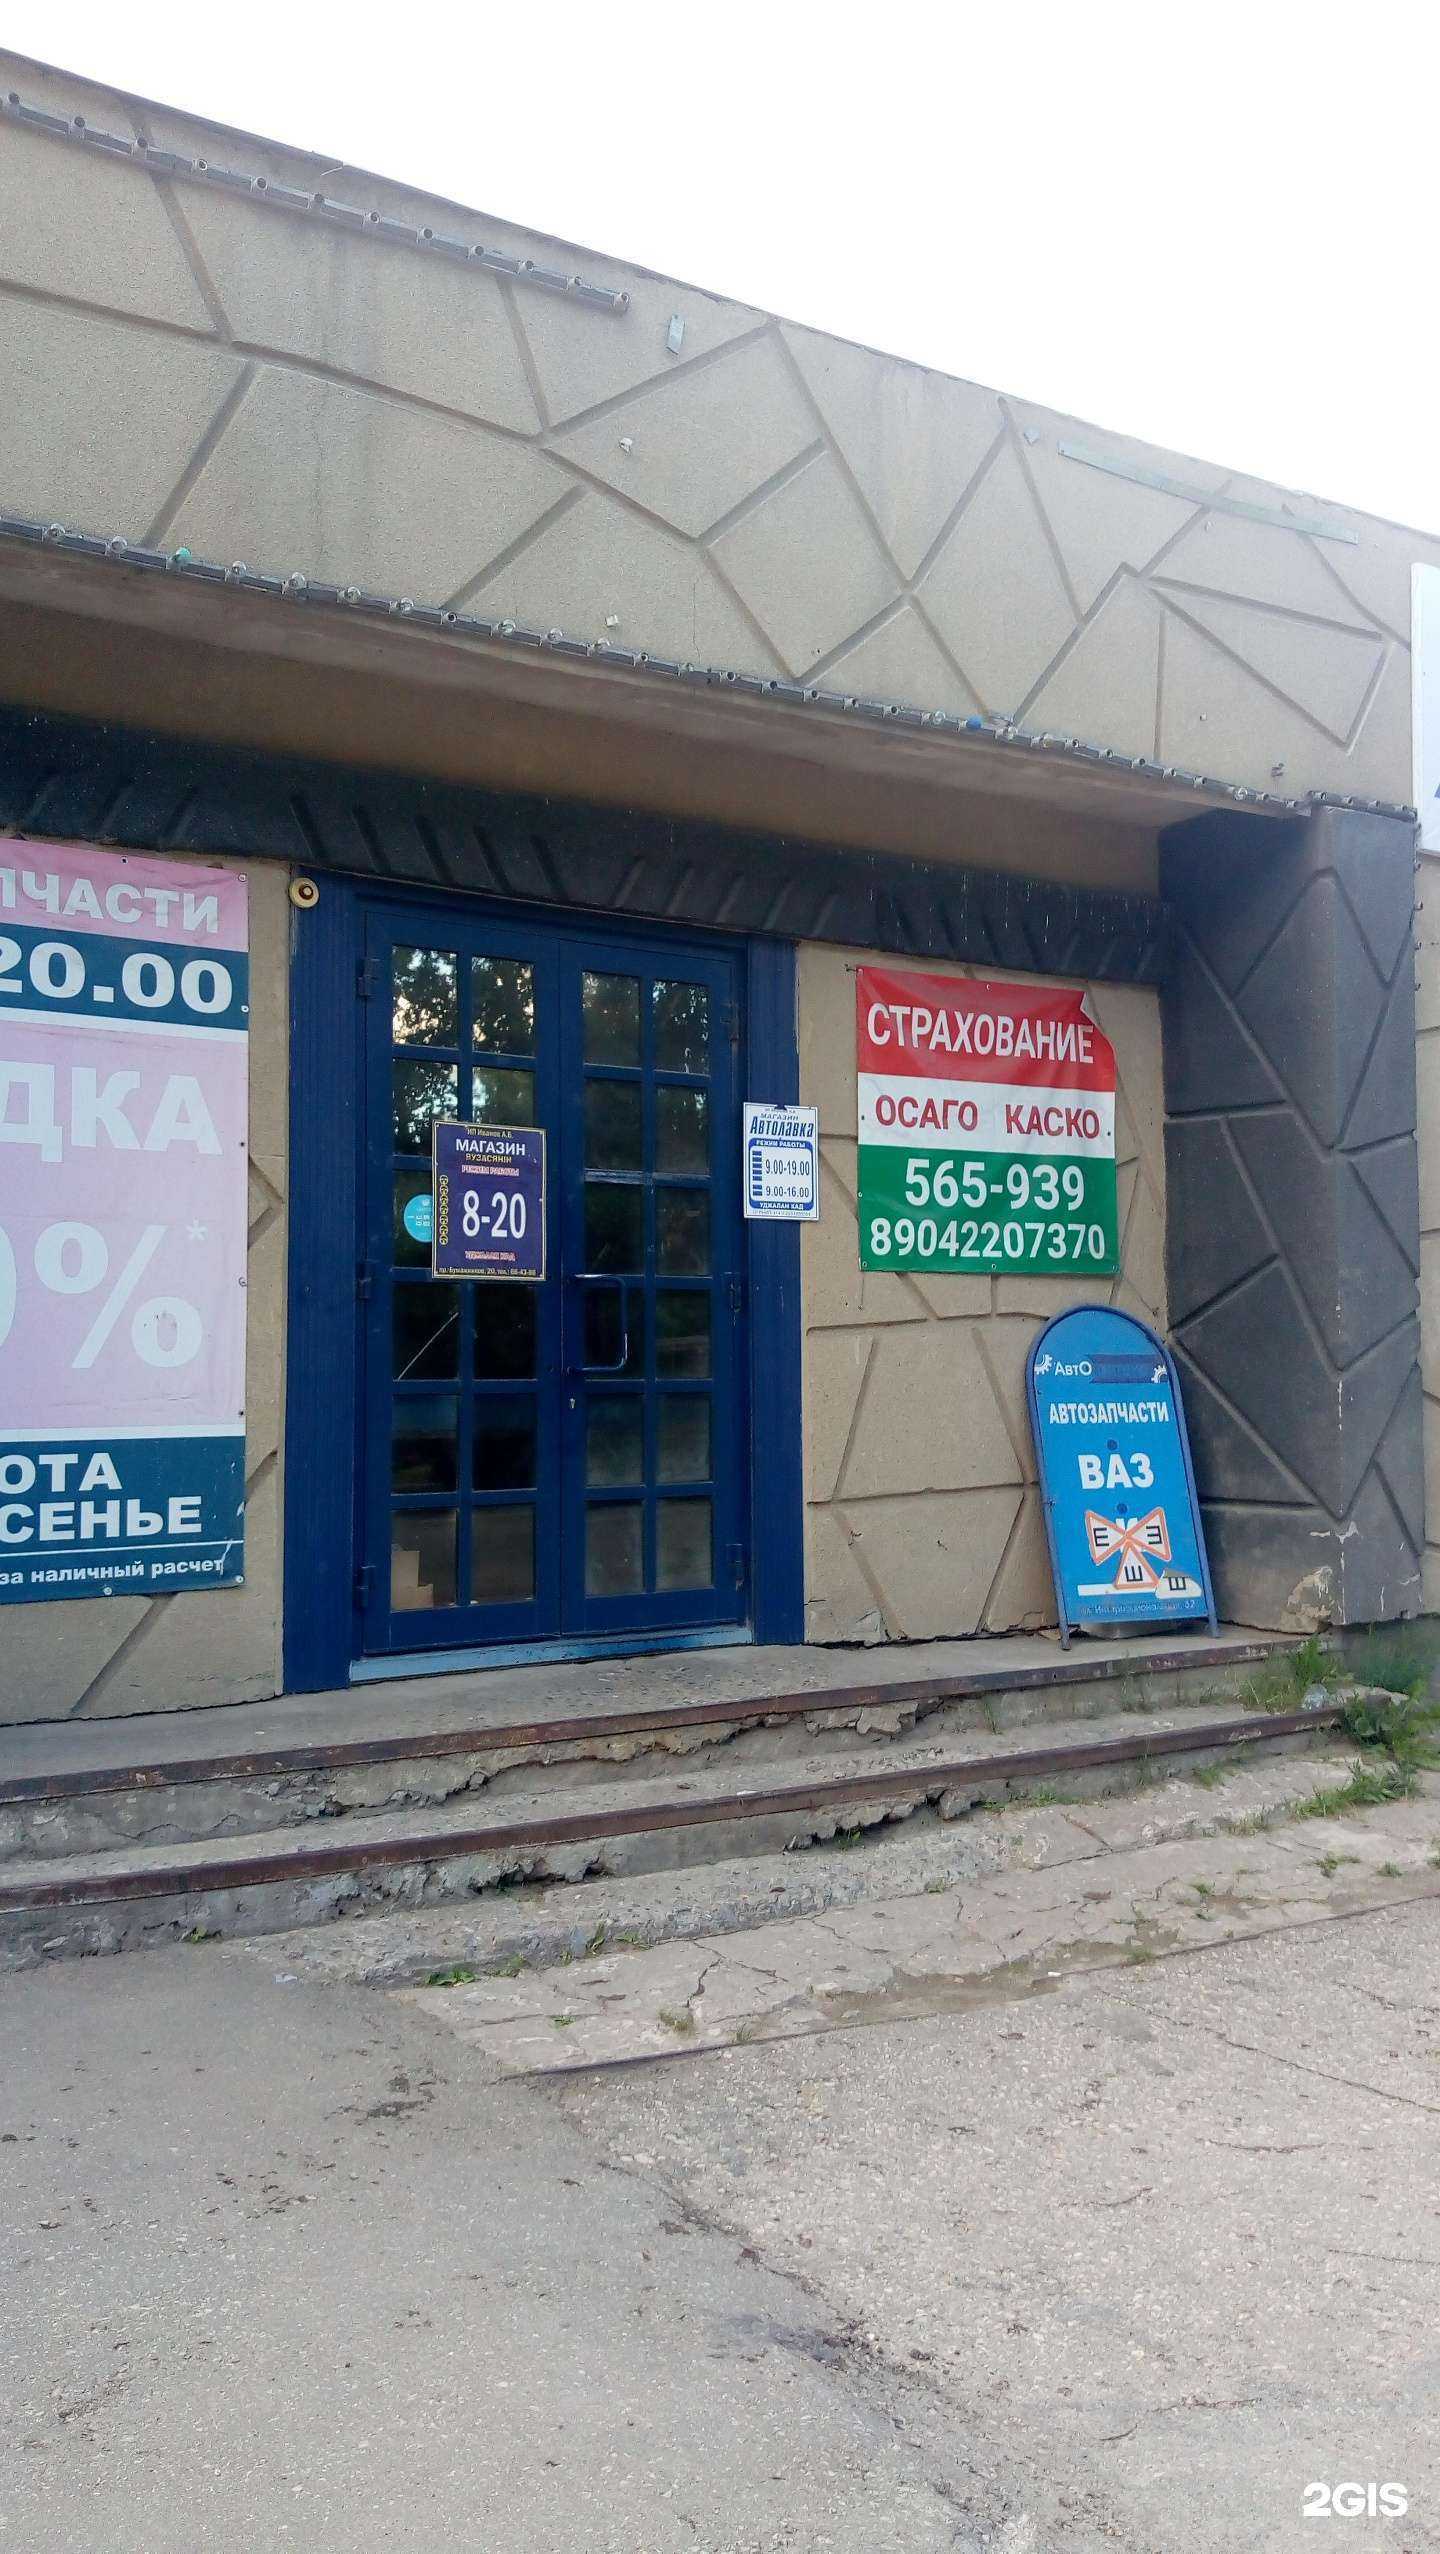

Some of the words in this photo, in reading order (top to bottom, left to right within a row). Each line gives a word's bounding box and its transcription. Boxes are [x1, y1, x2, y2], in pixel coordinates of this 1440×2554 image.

[866, 1001, 1095, 1065] СТРАХОВАНИЕ
[874, 1094, 980, 1131] ОСАГО
[1004, 1103, 1100, 1140] КАСКО
[455, 1138, 526, 1156] МАГАЗИН
[765, 1159, 810, 1176] 9.00-19.00
[765, 1186, 810, 1198] 9.00-16.00
[904, 1157, 1085, 1211] 565-939
[462, 1189, 527, 1239] 8-20
[869, 1217, 1106, 1261] 89042207370
[1049, 1400, 1169, 1425] АВТОЗАПЧАСТИ
[1077, 1452, 1154, 1490] ВАЗ
[0, 1496, 202, 1544] СЕНЬЕ
[31, 1560, 145, 1584] наличный
[151, 1558, 224, 1579] расчет
